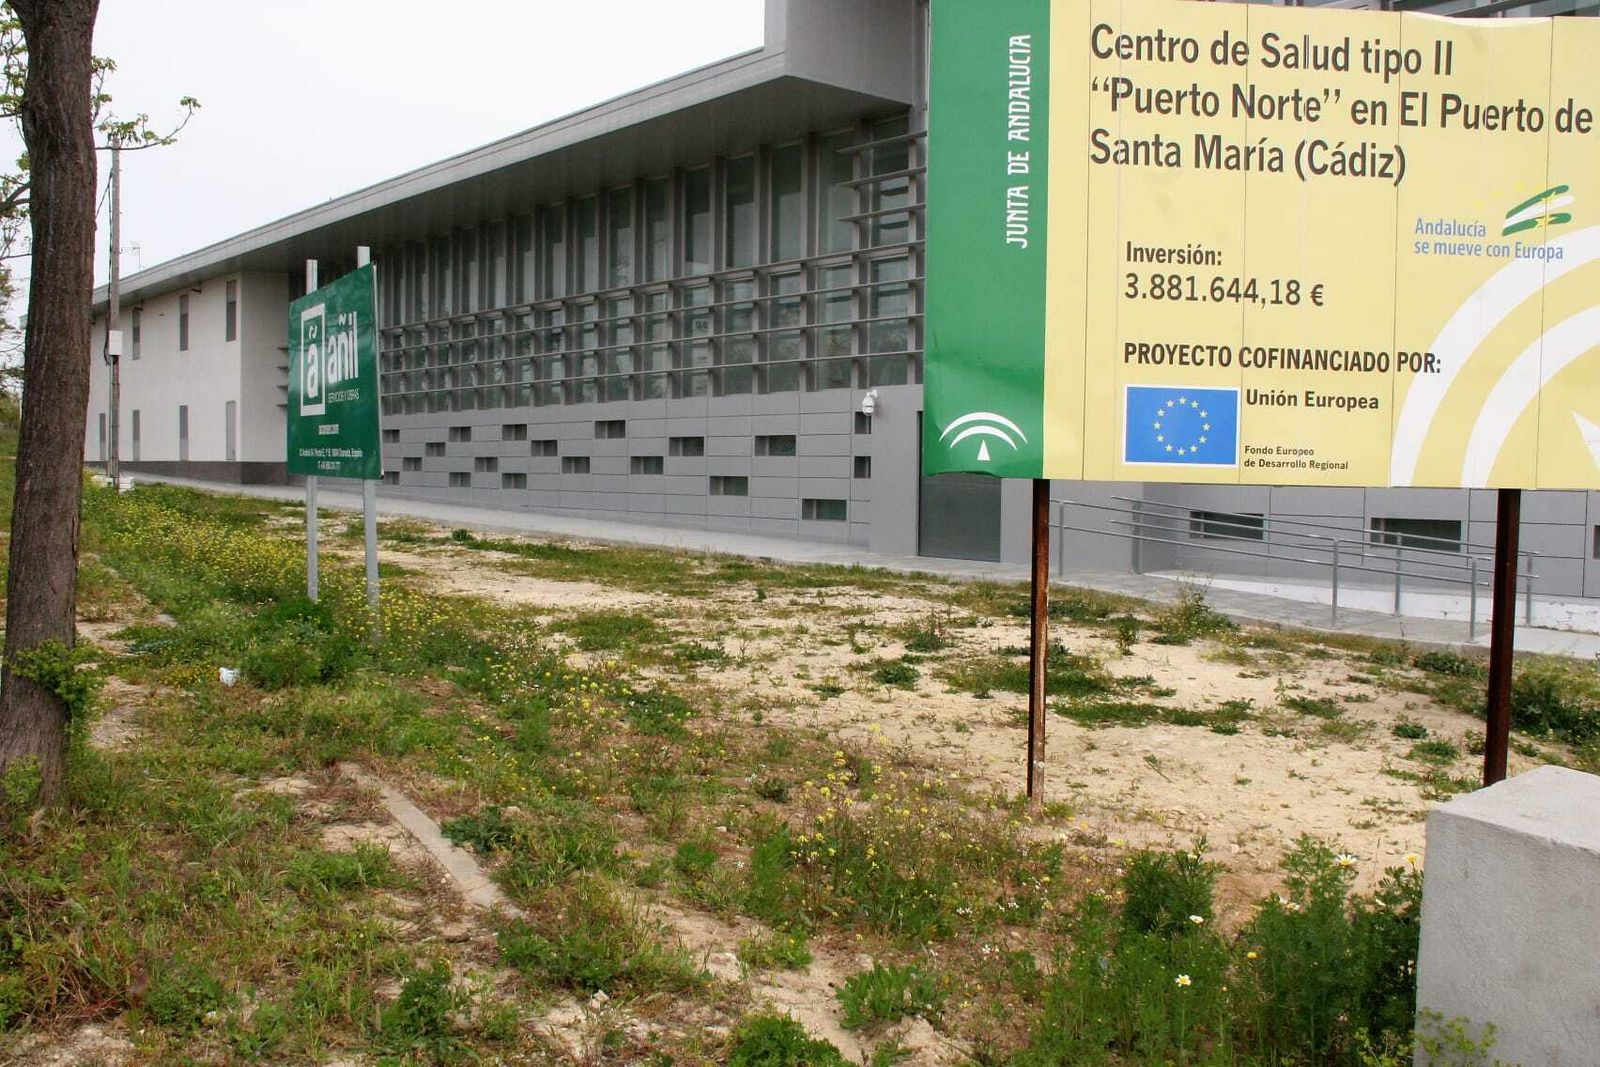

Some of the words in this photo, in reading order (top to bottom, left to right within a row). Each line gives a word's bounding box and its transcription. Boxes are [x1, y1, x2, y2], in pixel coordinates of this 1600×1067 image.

[1091, 23, 1199, 64] Centro
[1210, 30, 1249, 66] de
[1261, 32, 1349, 72] Salud
[1361, 38, 1422, 84] tipo
[1434, 40, 1453, 76] II
[1351, 99, 1387, 126] en
[1400, 91, 1428, 127] El
[1441, 93, 1544, 132] Puerto
[1555, 98, 1593, 134] de
[1007, 150, 1029, 175] DE
[1090, 128, 1181, 167] Santa
[1194, 133, 1284, 172] María
[1294, 139, 1406, 187] (Cádiz)
[1006, 185, 1029, 249] JUNTA
[1415, 217, 1486, 238] Andalucía
[1126, 241, 1222, 266] Inversión:
[1414, 240, 1429, 254] se
[1433, 241, 1482, 257] mueve
[1486, 244, 1510, 258] con
[1515, 241, 1564, 263] Europa
[1124, 272, 1301, 309] 3.881.644,18
[1310, 283, 1324, 307] €
[1124, 342, 1232, 367] PROYECTO
[1238, 346, 1390, 373] COFINANCIADO
[1396, 351, 1441, 374] POR:
[1246, 388, 1298, 407] Unión
[1304, 390, 1379, 412] Europea
[1244, 445, 1274, 456] Fondo
[1276, 446, 1314, 458] Europeo
[1244, 459, 1256, 468] de
[1258, 459, 1307, 469] Desarrollo
[1309, 460, 1349, 471] Regional
